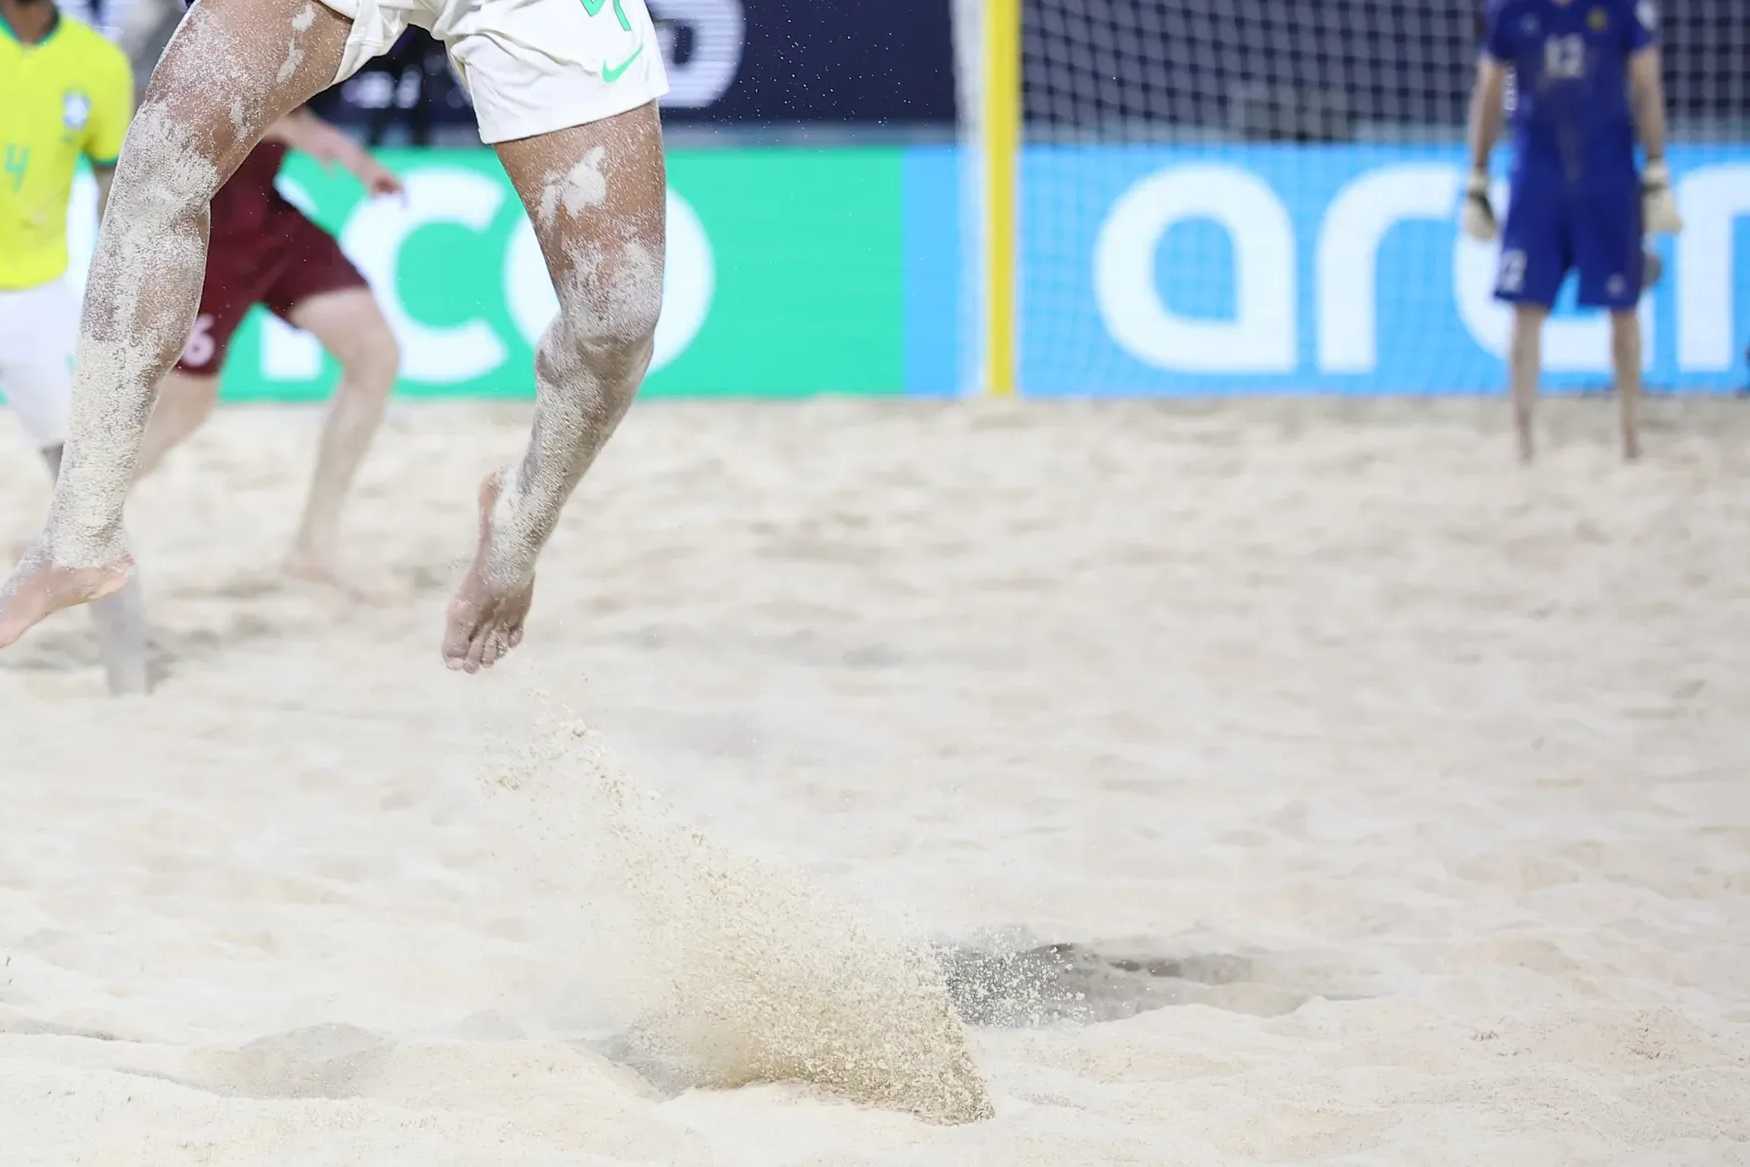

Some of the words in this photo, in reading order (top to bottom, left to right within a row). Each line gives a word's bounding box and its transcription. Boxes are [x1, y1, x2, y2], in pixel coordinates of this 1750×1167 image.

[4, 142, 31, 193] 4
[1095, 163, 1750, 373] ar
[181, 313, 216, 367] 6
